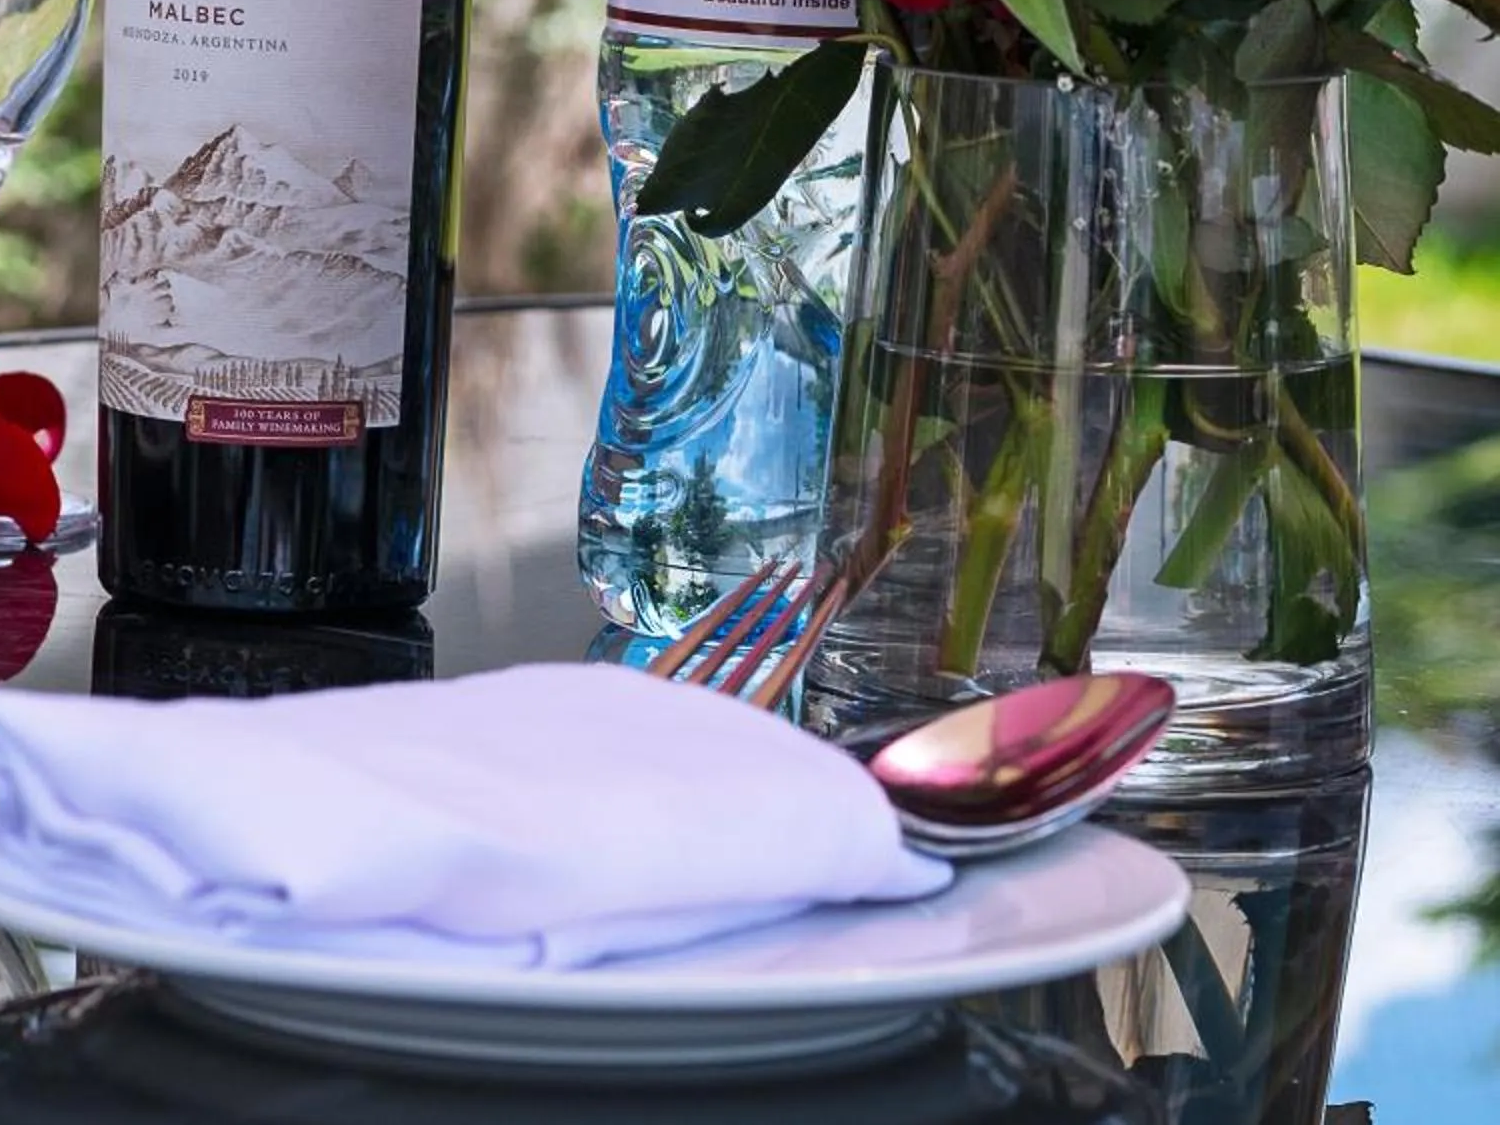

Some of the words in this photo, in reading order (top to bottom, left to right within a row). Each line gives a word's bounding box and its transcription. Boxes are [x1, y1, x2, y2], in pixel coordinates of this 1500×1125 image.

[148, 0, 246, 27] MALBEC
[190, 35, 289, 53] ARGENTINA
[173, 67, 210, 83] 2019
[234, 408, 255, 421] 100
[258, 410, 299, 422] YEARS
[303, 411, 322, 422] OF
[211, 418, 256, 433] FAMILY
[258, 420, 342, 435] WINEMAKING
